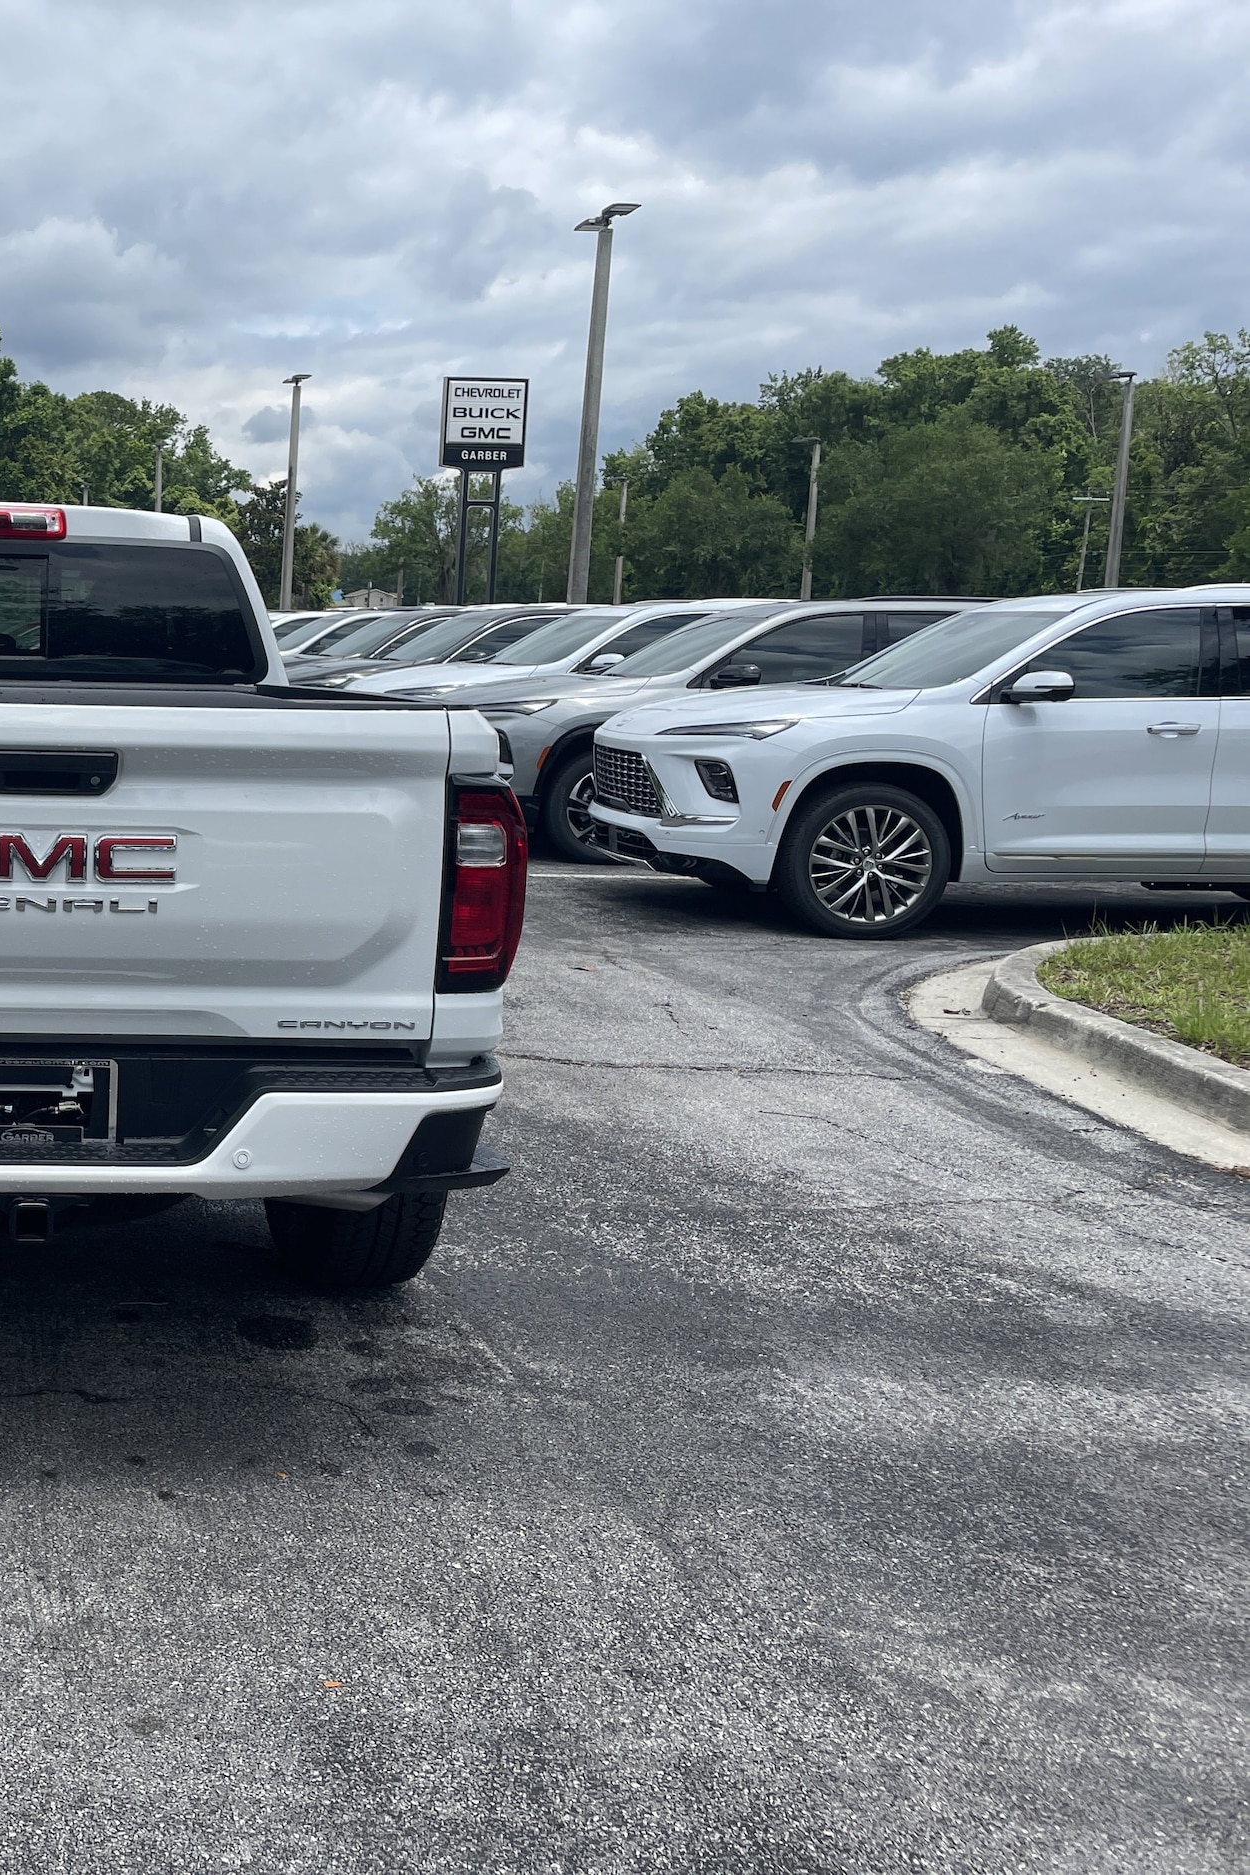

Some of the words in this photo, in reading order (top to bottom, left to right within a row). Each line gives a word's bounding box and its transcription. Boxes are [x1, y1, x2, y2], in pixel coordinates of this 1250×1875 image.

[454, 387, 522, 399] CHEVROLET
[452, 407, 521, 419] BUICK
[460, 427, 511, 439] GMC
[461, 450, 507, 460] GARBER
[277, 1019, 415, 1030] CANYON
